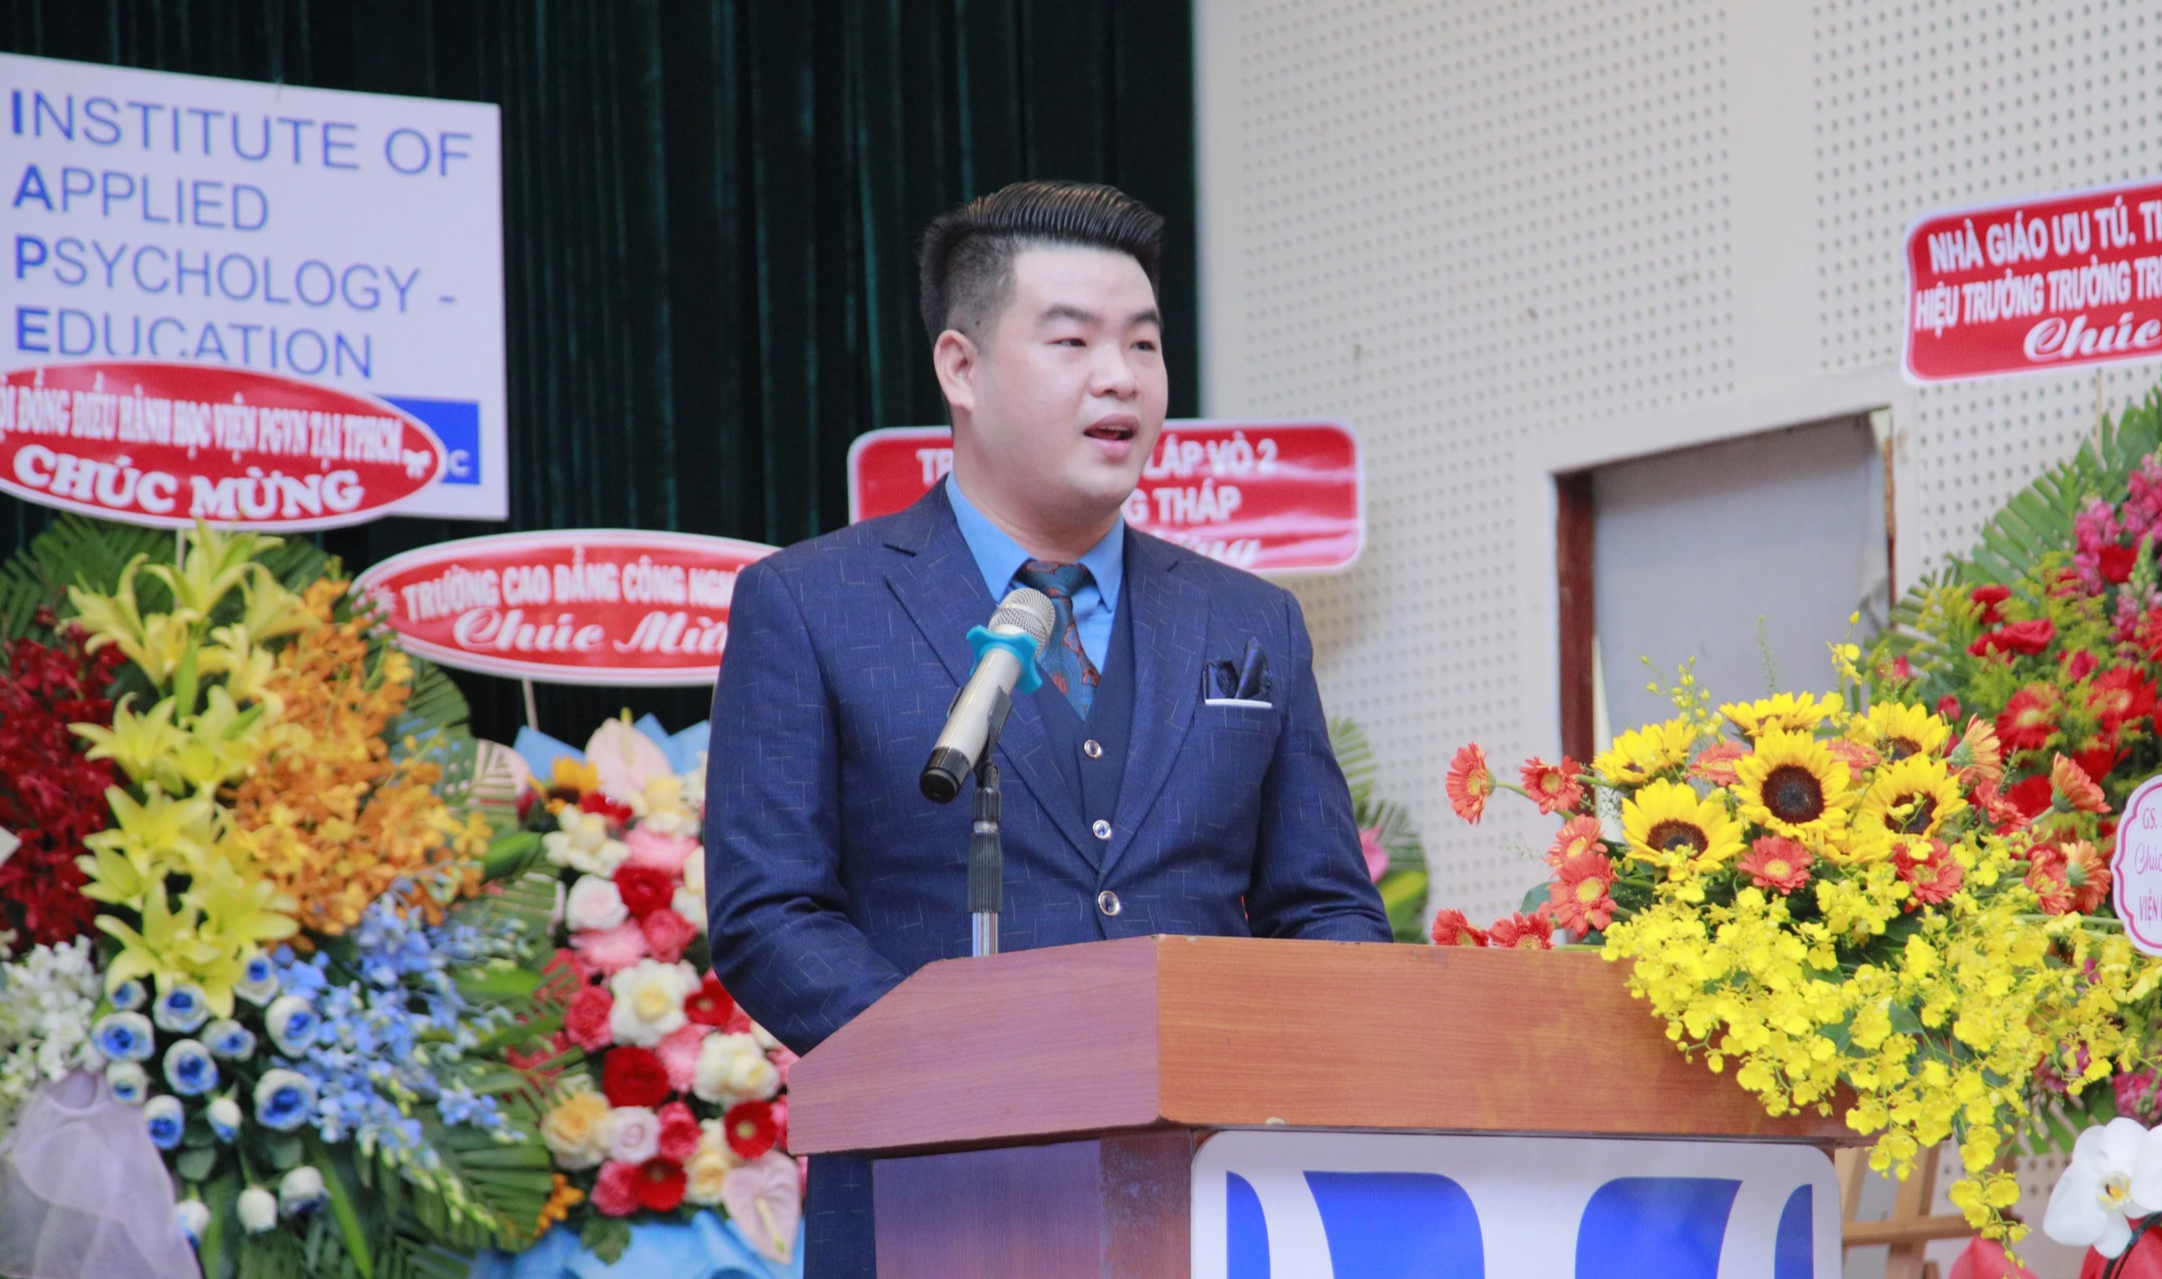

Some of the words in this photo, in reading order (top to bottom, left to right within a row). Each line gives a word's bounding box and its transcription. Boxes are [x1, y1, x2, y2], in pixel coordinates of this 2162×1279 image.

[11, 89, 360, 170] INSTITUTE
[385, 127, 473, 177] OF
[12, 162, 270, 231] APPLIED
[1928, 217, 1984, 274] NHÀ
[1986, 209, 2049, 266] GIÁO
[2052, 210, 2092, 257] ƯU
[2094, 195, 2136, 250] TÚ.
[15, 234, 421, 313] PSYCHOLOGY
[1914, 280, 1961, 338] HIỆU
[1962, 267, 2045, 325] TRƯỞNG
[2046, 253, 2132, 313] TRƯỜNG
[16, 306, 373, 379] EDUCATION
[2023, 312, 2162, 362] Chúc
[13, 444, 177, 513] CHÚC
[188, 465, 366, 520] MỪNG
[1256, 437, 1279, 477] 2
[1152, 477, 1242, 524] THÁP
[401, 563, 500, 623] TRƯỜNG
[501, 565, 552, 607] CAO
[621, 555, 686, 605] CÔNG
[688, 565, 738, 609] NGH
[453, 607, 604, 653] Chúc
